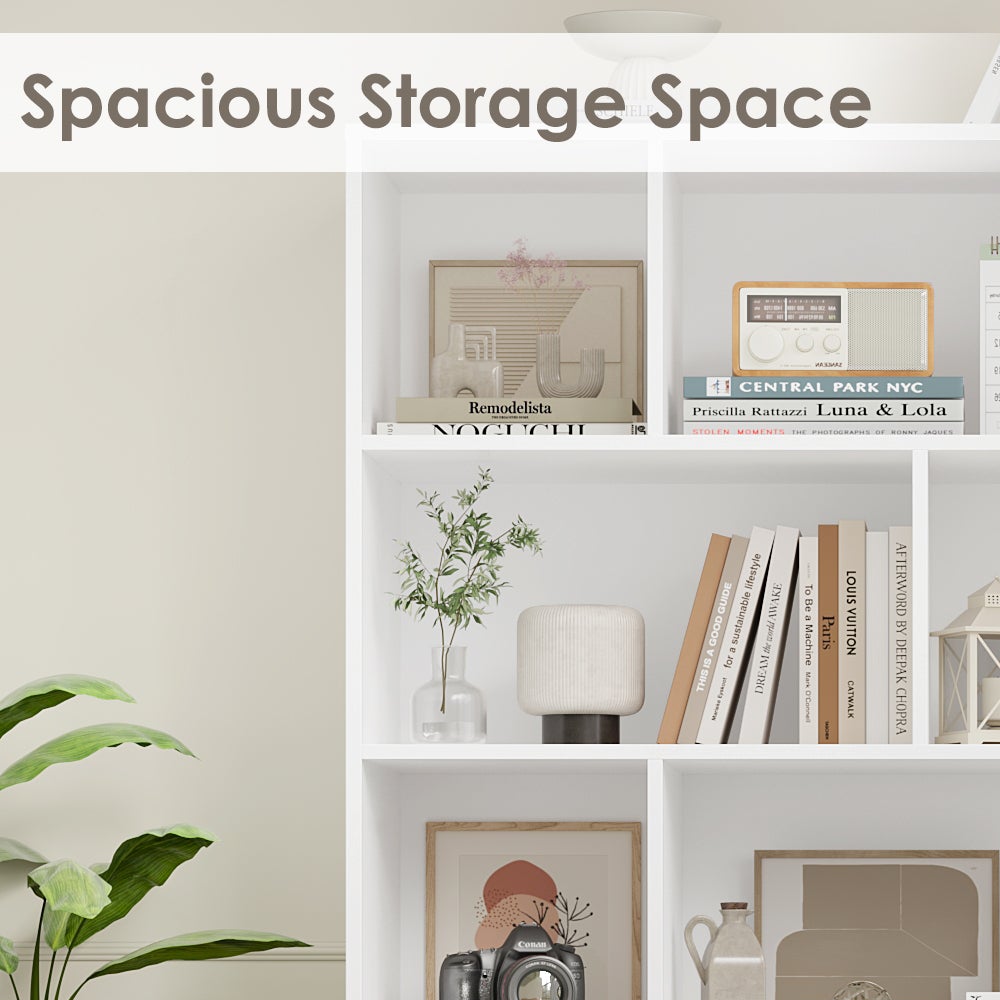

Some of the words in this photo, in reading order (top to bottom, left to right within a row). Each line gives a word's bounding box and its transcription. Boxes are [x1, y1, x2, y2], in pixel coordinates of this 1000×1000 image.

[739, 382, 824, 392] CENTRAL
[833, 382, 879, 392] PARK
[887, 382, 923, 392] NYC
[469, 402, 552, 414] Remodelista
[693, 407, 746, 416] Priscilla
[752, 407, 807, 416] Rattazzi
[816, 404, 868, 416] Luna
[876, 404, 893, 416] &
[902, 404, 947, 416] Lola
[804, 584, 813, 595] To
[847, 571, 856, 604] LOUIS
[896, 543, 907, 617] AFTERWORD
[724, 655, 733, 669] for
[731, 591, 752, 645] sustainable
[744, 553, 762, 589] lifestyle
[769, 583, 783, 620] AWAKE
[805, 599, 813, 612] Be
[696, 669, 707, 691] THIS
[702, 658, 710, 668] IS
[706, 649, 713, 657] A
[710, 616, 724, 646] GOOD
[718, 582, 731, 614] GUIDE
[765, 621, 776, 641] world
[822, 616, 835, 650] Paris
[847, 609, 856, 655] VUITTON
[896, 620, 907, 635] BY
[763, 643, 773, 653] the
[805, 624, 813, 666] Machine
[896, 640, 907, 682] DEEPAK
[755, 655, 769, 694] DREAM
[896, 688, 907, 735] CHOPRA
